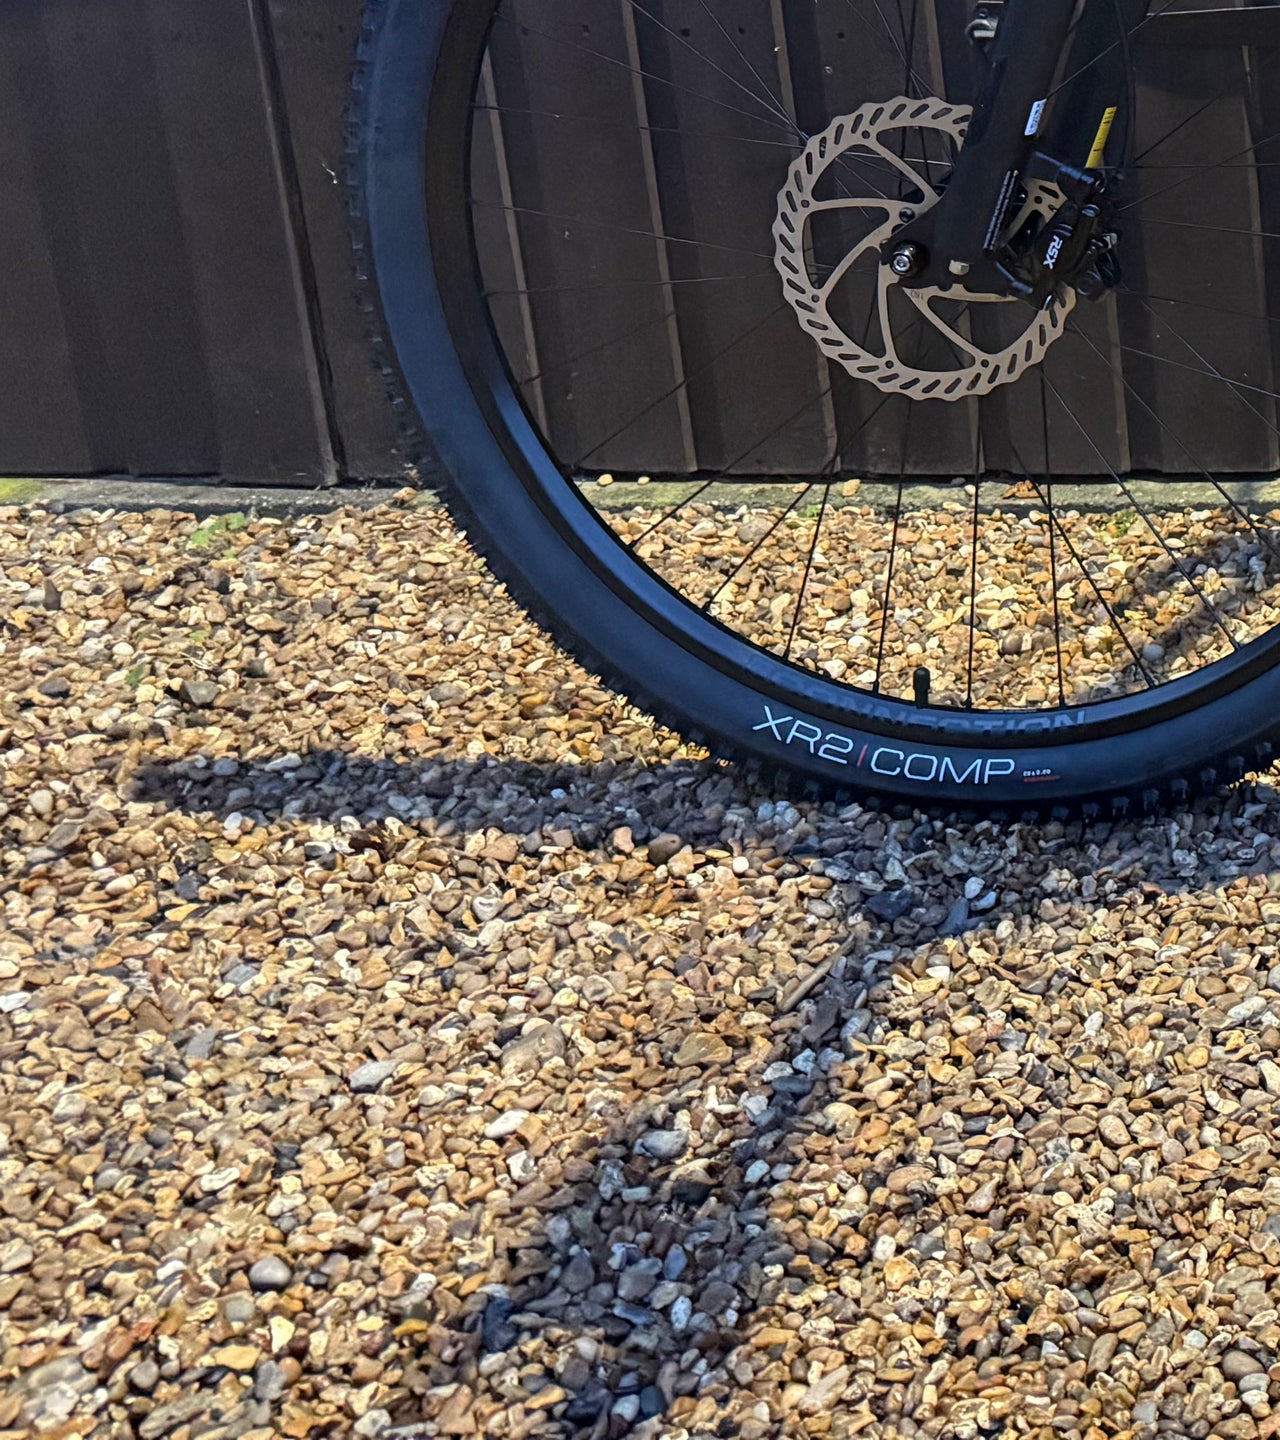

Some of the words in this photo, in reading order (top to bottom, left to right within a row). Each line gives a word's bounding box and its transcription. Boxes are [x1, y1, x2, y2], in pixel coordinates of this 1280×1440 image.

[1042, 235, 1064, 270] RSX
[752, 705, 854, 765] XR2
[870, 747, 1015, 785] COMP
